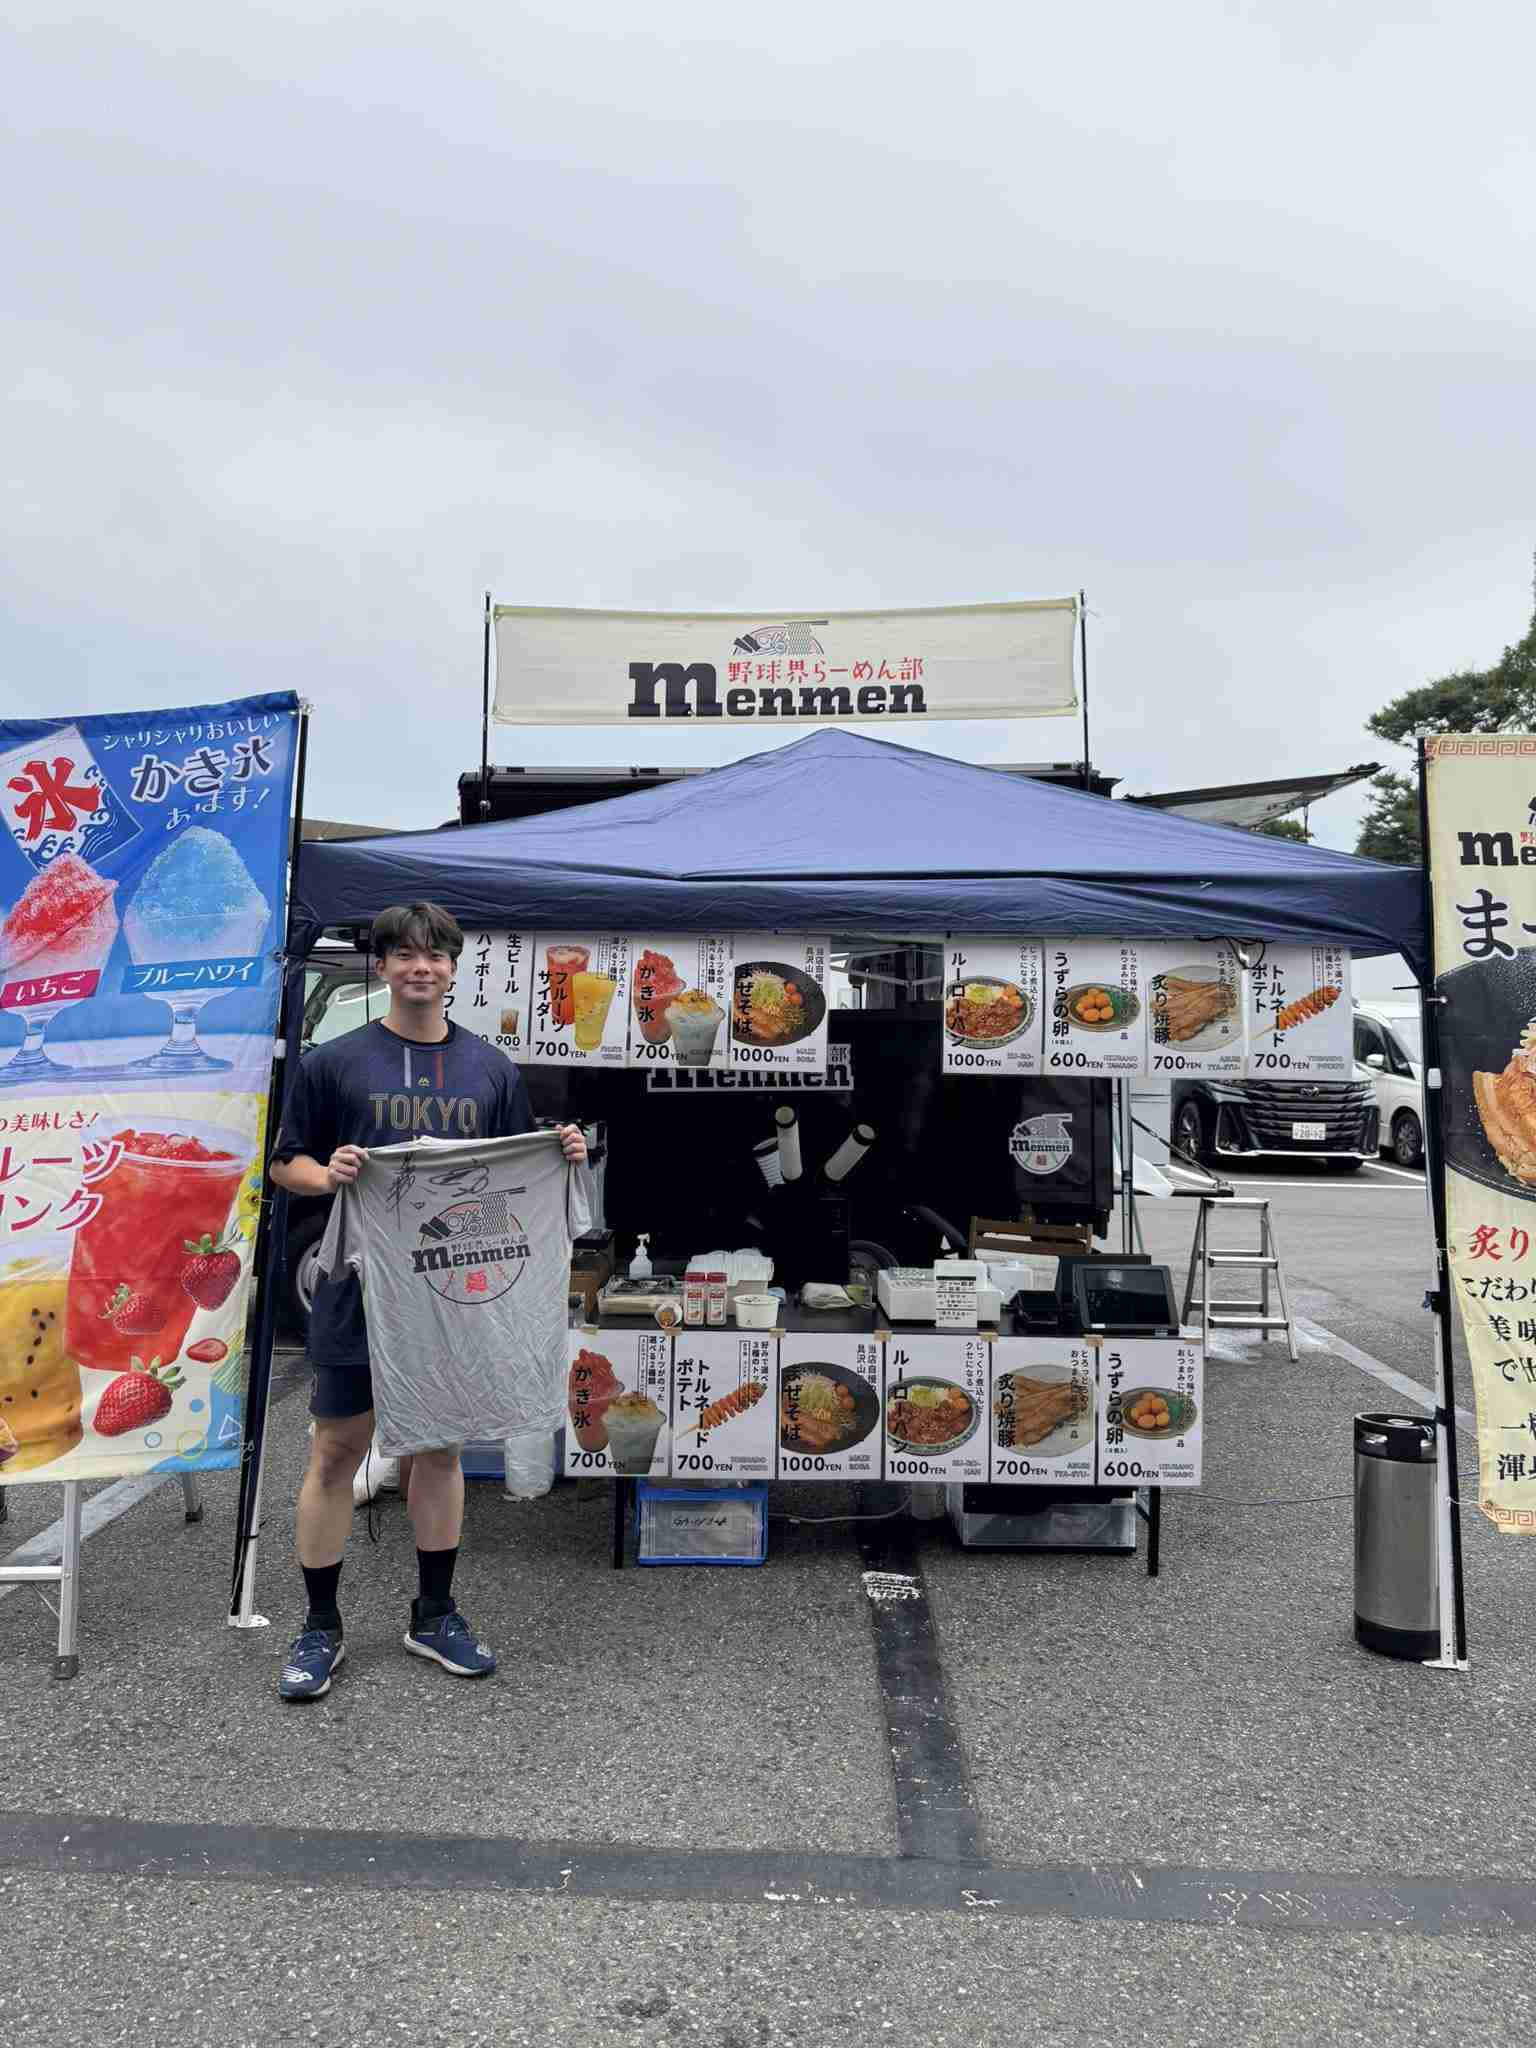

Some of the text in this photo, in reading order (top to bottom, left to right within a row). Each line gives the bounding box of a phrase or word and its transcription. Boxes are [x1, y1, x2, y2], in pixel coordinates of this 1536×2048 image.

[629, 662, 927, 717] menmen
[728, 658, 924, 684] 野球界らーめん部
[103, 714, 280, 751] シャリシャリおいしい
[134, 736, 273, 802] かき氷
[8, 757, 101, 841] 氷
[16, 972, 87, 1002] いちご
[135, 962, 255, 986] ブルーハワイ
[473, 933, 492, 1007] ハイボール
[506, 933, 522, 993] 生ビール
[1019, 945, 1028, 992] クセになる一
[1251, 963, 1268, 1014] ポテト
[536, 971, 554, 1032] サイダー
[553, 972, 569, 1033] フルーツ
[639, 965, 656, 1022] かき氷
[1052, 952, 1070, 1037] うずらの卵
[1269, 965, 1286, 1048] トルネード
[496, 1035, 521, 1046] 900
[369, 1092, 478, 1133] TOKYO
[1011, 1137, 1071, 1153] menmen
[0, 1189, 103, 1233] ンク
[411, 1244, 531, 1274] menmen
[1468, 1224, 1530, 1262] 炙り
[676, 1358, 693, 1411] ポテト
[965, 1342, 974, 1393] クセになる一
[976, 1342, 984, 1417] じっくり煮込んだ
[574, 1366, 592, 1427] かき氷
[694, 1360, 711, 1448] トルネード
[998, 1374, 1016, 1448] 炙り焼豚
[1106, 1353, 1124, 1445] うずらの卵
